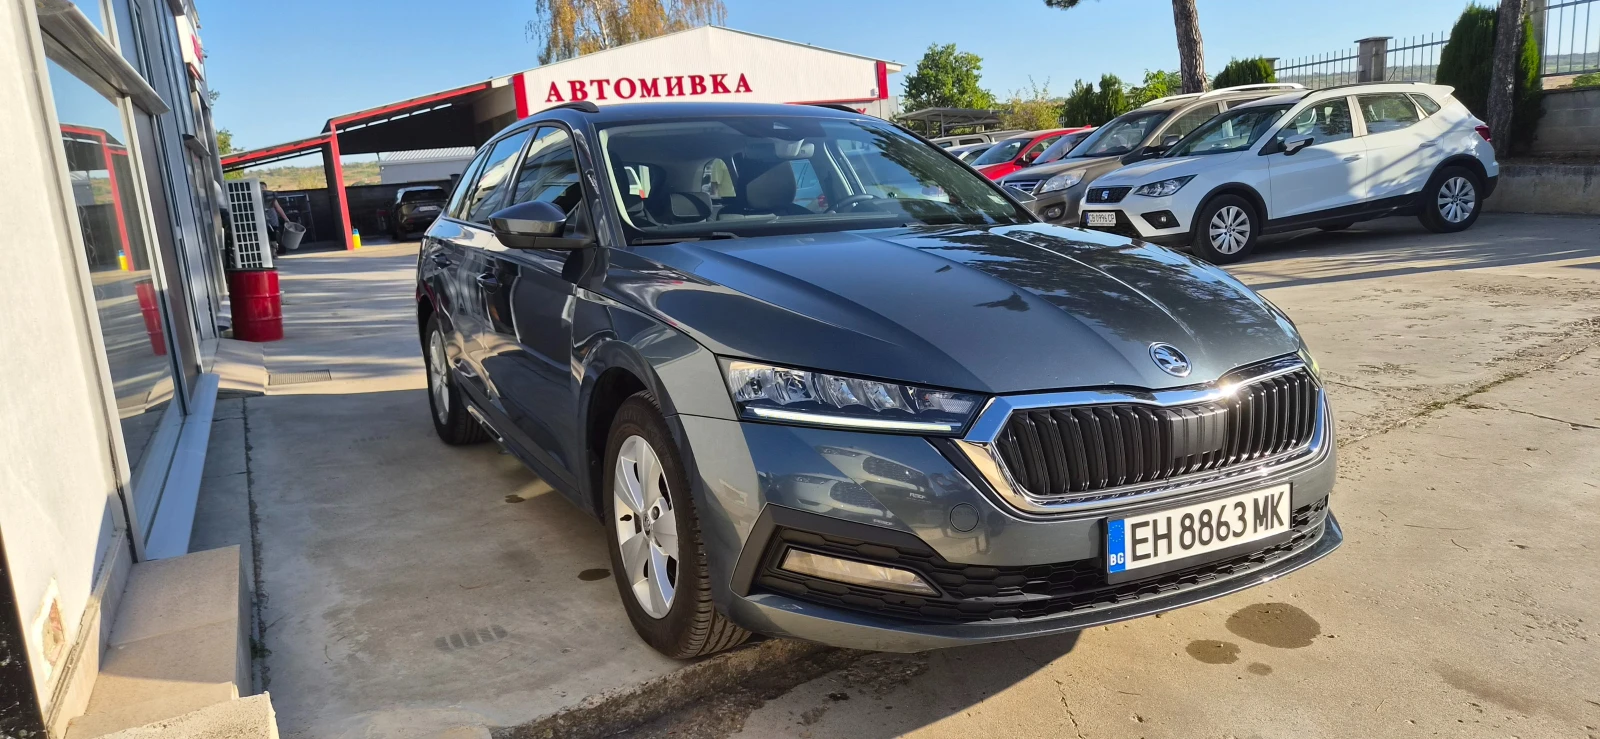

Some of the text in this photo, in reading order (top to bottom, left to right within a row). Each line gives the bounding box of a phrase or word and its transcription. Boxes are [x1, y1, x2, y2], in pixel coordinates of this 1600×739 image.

[545, 73, 752, 102] АВТОМИВКА
[1131, 491, 1285, 563] EH 8863 MK
[1110, 552, 1125, 566] BG
